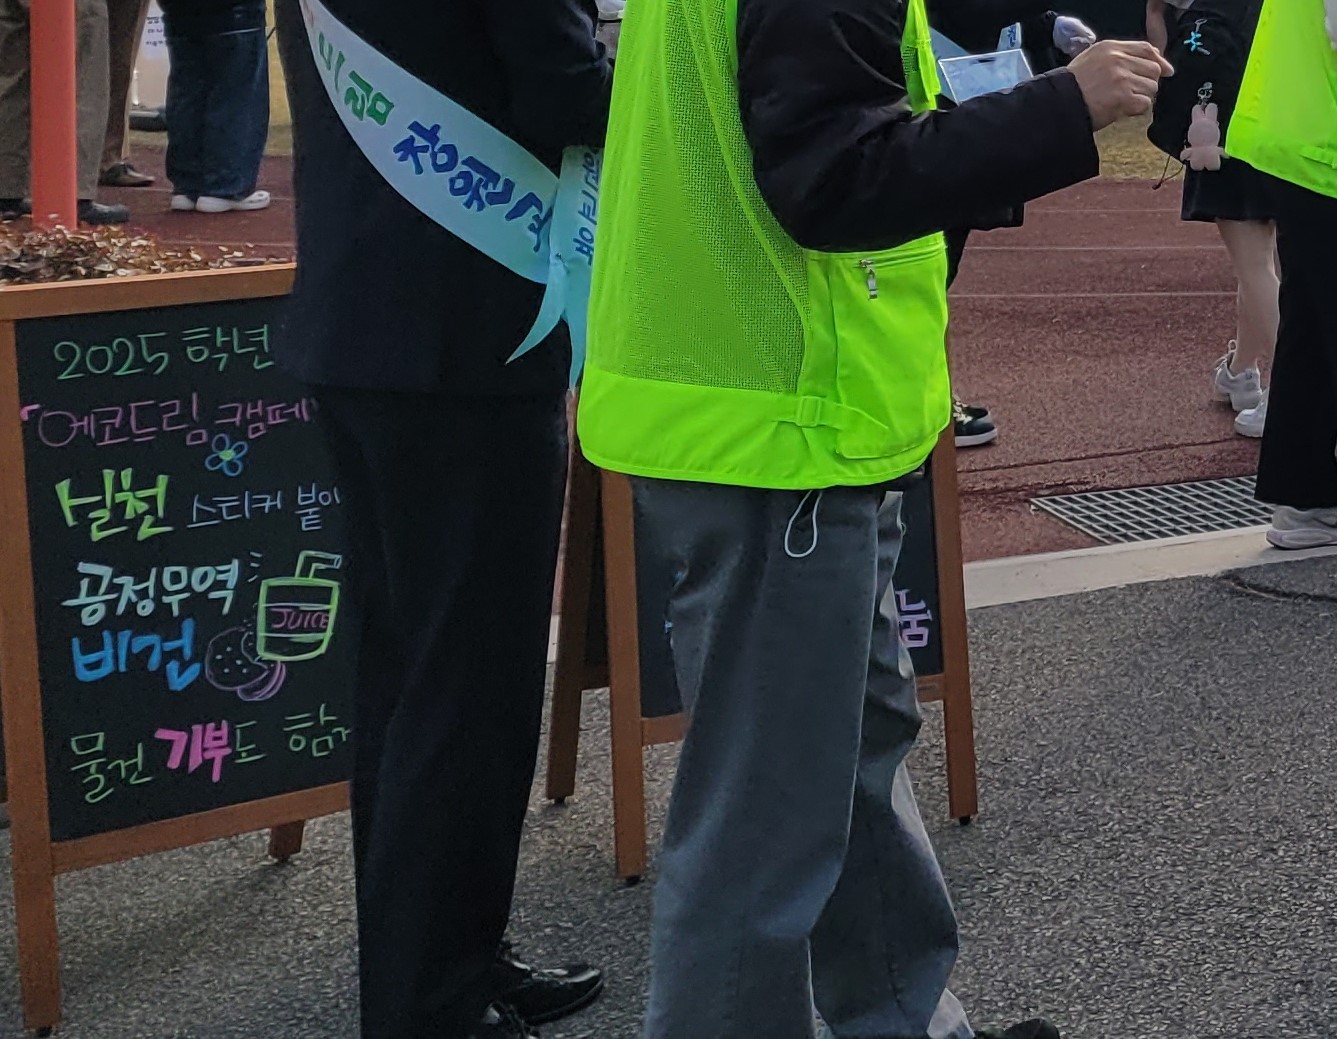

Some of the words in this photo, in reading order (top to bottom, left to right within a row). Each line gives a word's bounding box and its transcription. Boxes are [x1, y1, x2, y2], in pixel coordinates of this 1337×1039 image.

[53, 331, 169, 381] 2025
[181, 323, 275, 372] 학년
[214, 396, 317, 440] 캠페
[55, 467, 175, 542] 실천
[187, 490, 283, 528] 스티커
[295, 482, 341, 532] 붙이
[61, 559, 240, 627] 공정무역
[270, 607, 330, 630] JUICE
[72, 618, 202, 692] 비건
[70, 731, 153, 804] 물건
[153, 719, 268, 784] 기부도
